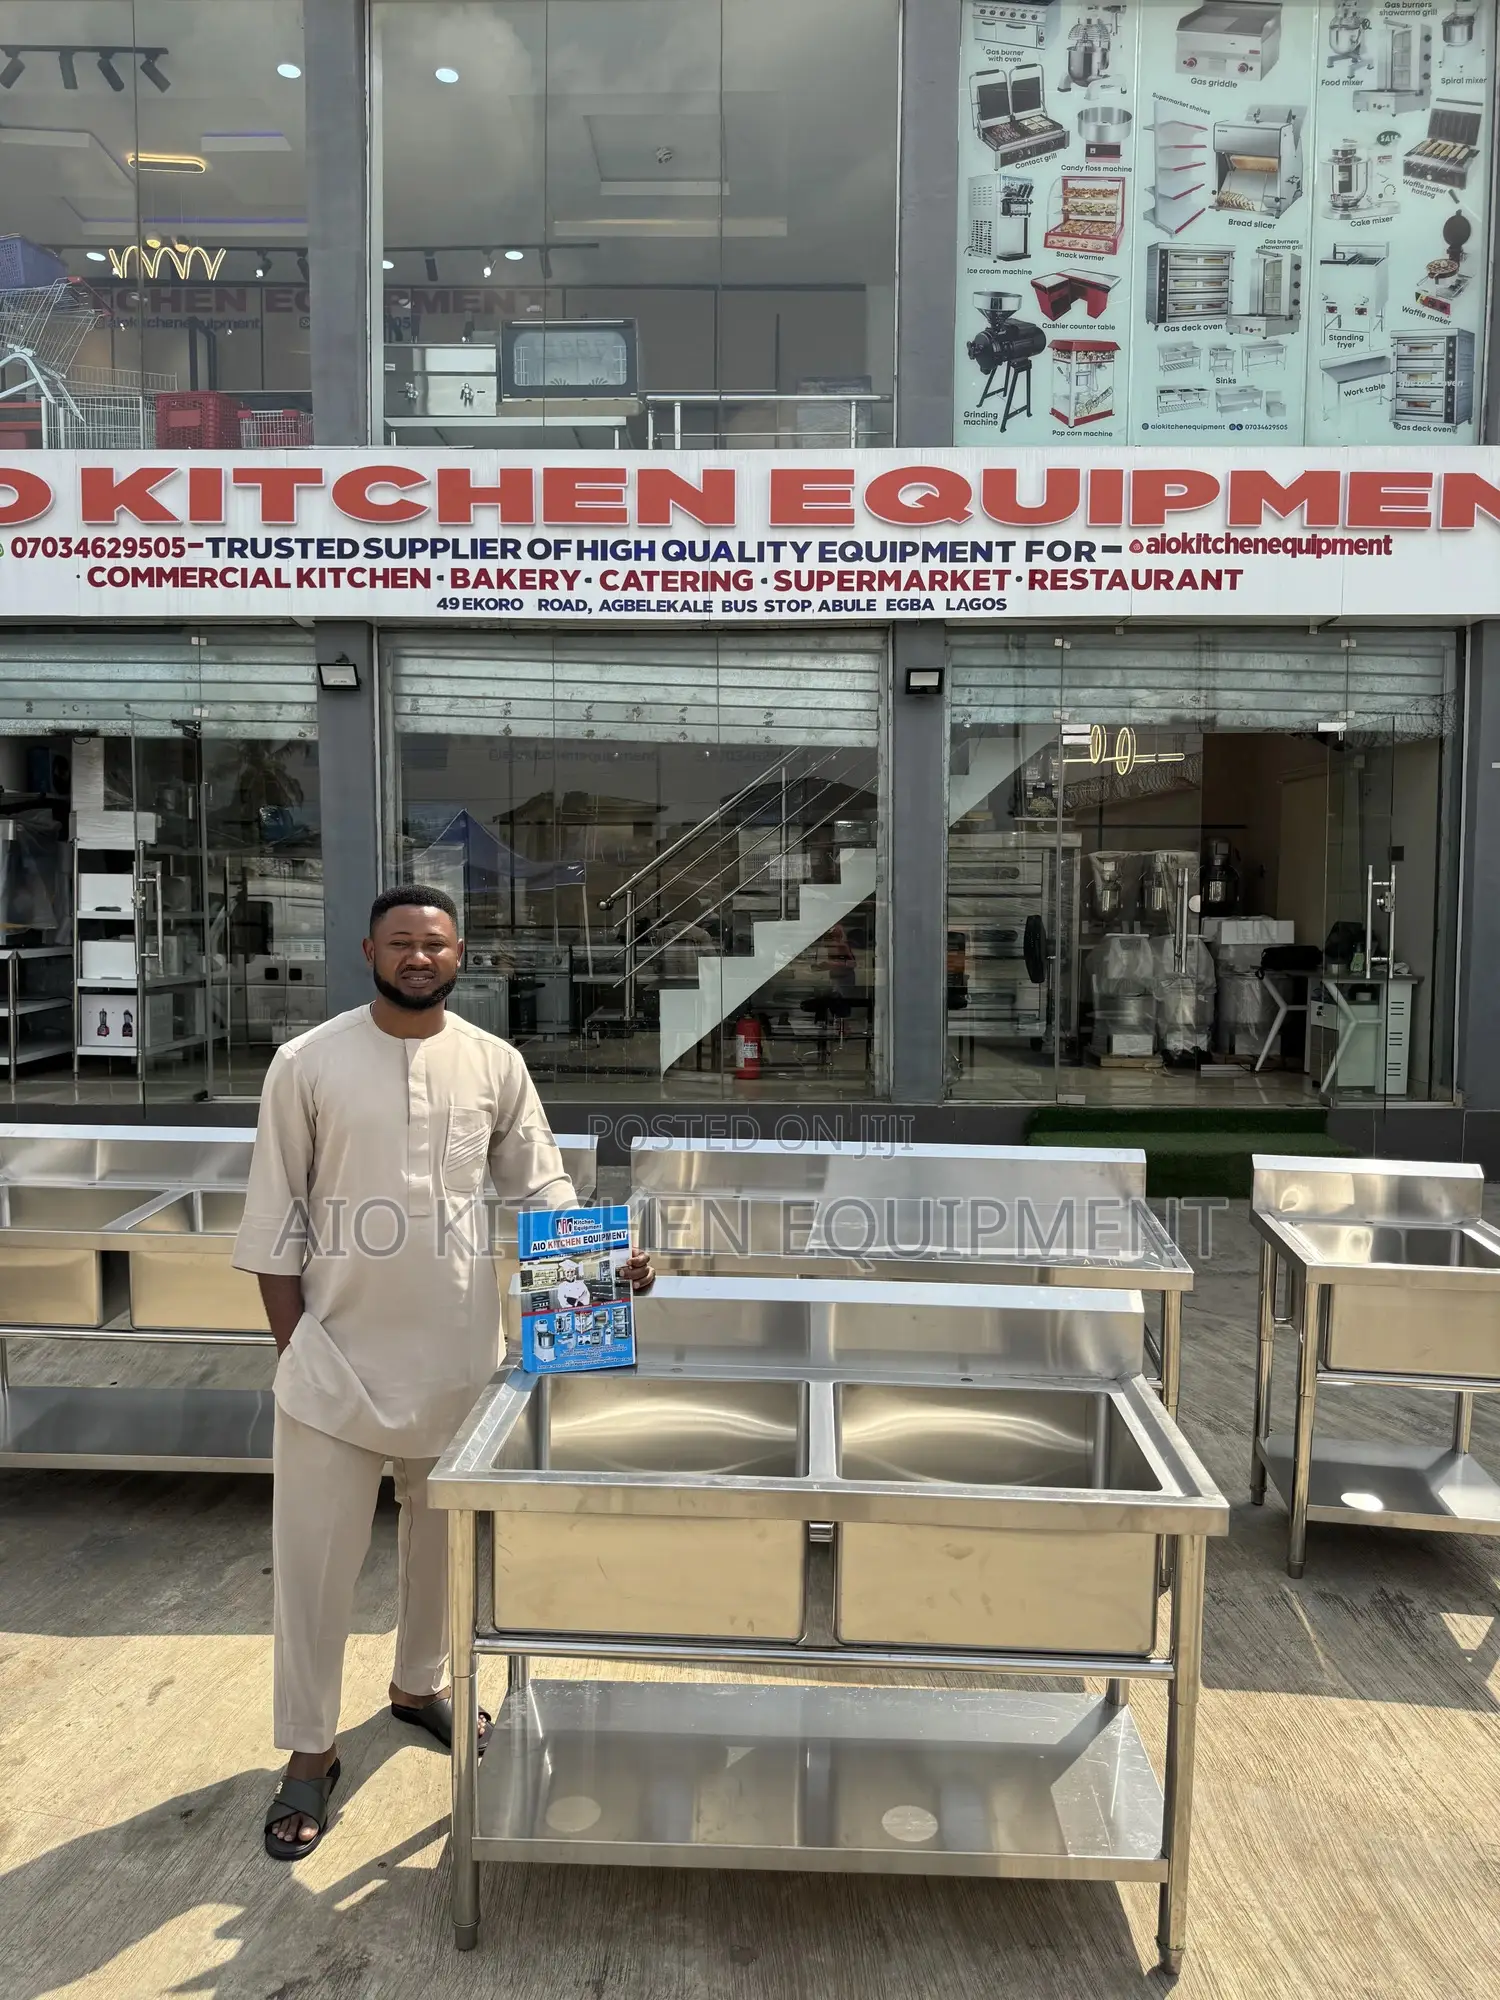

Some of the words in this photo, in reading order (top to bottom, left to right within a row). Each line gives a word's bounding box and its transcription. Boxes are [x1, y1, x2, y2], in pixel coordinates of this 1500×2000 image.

[1208, 78, 1238, 88] griddle
[1441, 77, 1464, 85] Spiral
[1152, 92, 1190, 109] Supermarket
[1189, 104, 1211, 115] shelves
[1015, 156, 1044, 169] Contact
[1044, 152, 1058, 162] grill
[1061, 164, 1084, 174] Candy
[1085, 164, 1101, 174] floss
[1402, 178, 1424, 190] Waffle
[1425, 184, 1447, 195] maker
[1411, 188, 1436, 199] hotdog
[1228, 218, 1252, 227] Bread
[1254, 220, 1276, 230] slicer
[1350, 218, 1372, 227] Cake
[1372, 216, 1394, 224] mixer
[1056, 252, 1076, 260] Snack
[1402, 306, 1426, 319] Waffle
[1427, 314, 1452, 326] maker
[1164, 324, 1180, 332] Gas
[1181, 324, 1202, 332] deck
[1329, 334, 1364, 342] Standing
[1337, 340, 1356, 349] fryer
[1344, 388, 1364, 397] Work
[1365, 384, 1386, 392] table
[964, 410, 998, 420] Grinding
[964, 418, 998, 426] machine
[1150, 423, 1226, 432] aiokitchenequipment
[1052, 430, 1064, 438] Pop
[81, 465, 736, 526] KITCHEN
[364, 537, 521, 560] SUPPLIER
[527, 538, 571, 561] OF
[578, 538, 656, 562] HIGH
[661, 539, 811, 564] QUALITY
[818, 540, 1016, 563] EQUIPMENT
[1146, 531, 1393, 559] aiokitchenequipment
[87, 565, 291, 589] COMMERCIAL
[297, 567, 431, 589] KITCHEN
[451, 567, 582, 591] BAKERY
[599, 568, 753, 592] CATERING
[773, 569, 1012, 592] SUPERMARKET
[1028, 568, 1244, 592] RESTAURANT
[436, 596, 460, 610] 49
[463, 597, 524, 612] EKORO
[599, 598, 714, 613] AGBELEKALE
[721, 598, 758, 613] BUS
[818, 598, 876, 613] ABULE
[886, 598, 935, 612] EGBA
[945, 597, 1007, 612] LAGOS
[532, 1242, 546, 1252] AIO
[548, 1237, 581, 1249] KITCHEN
[584, 1231, 626, 1244] EQUIPMENT
